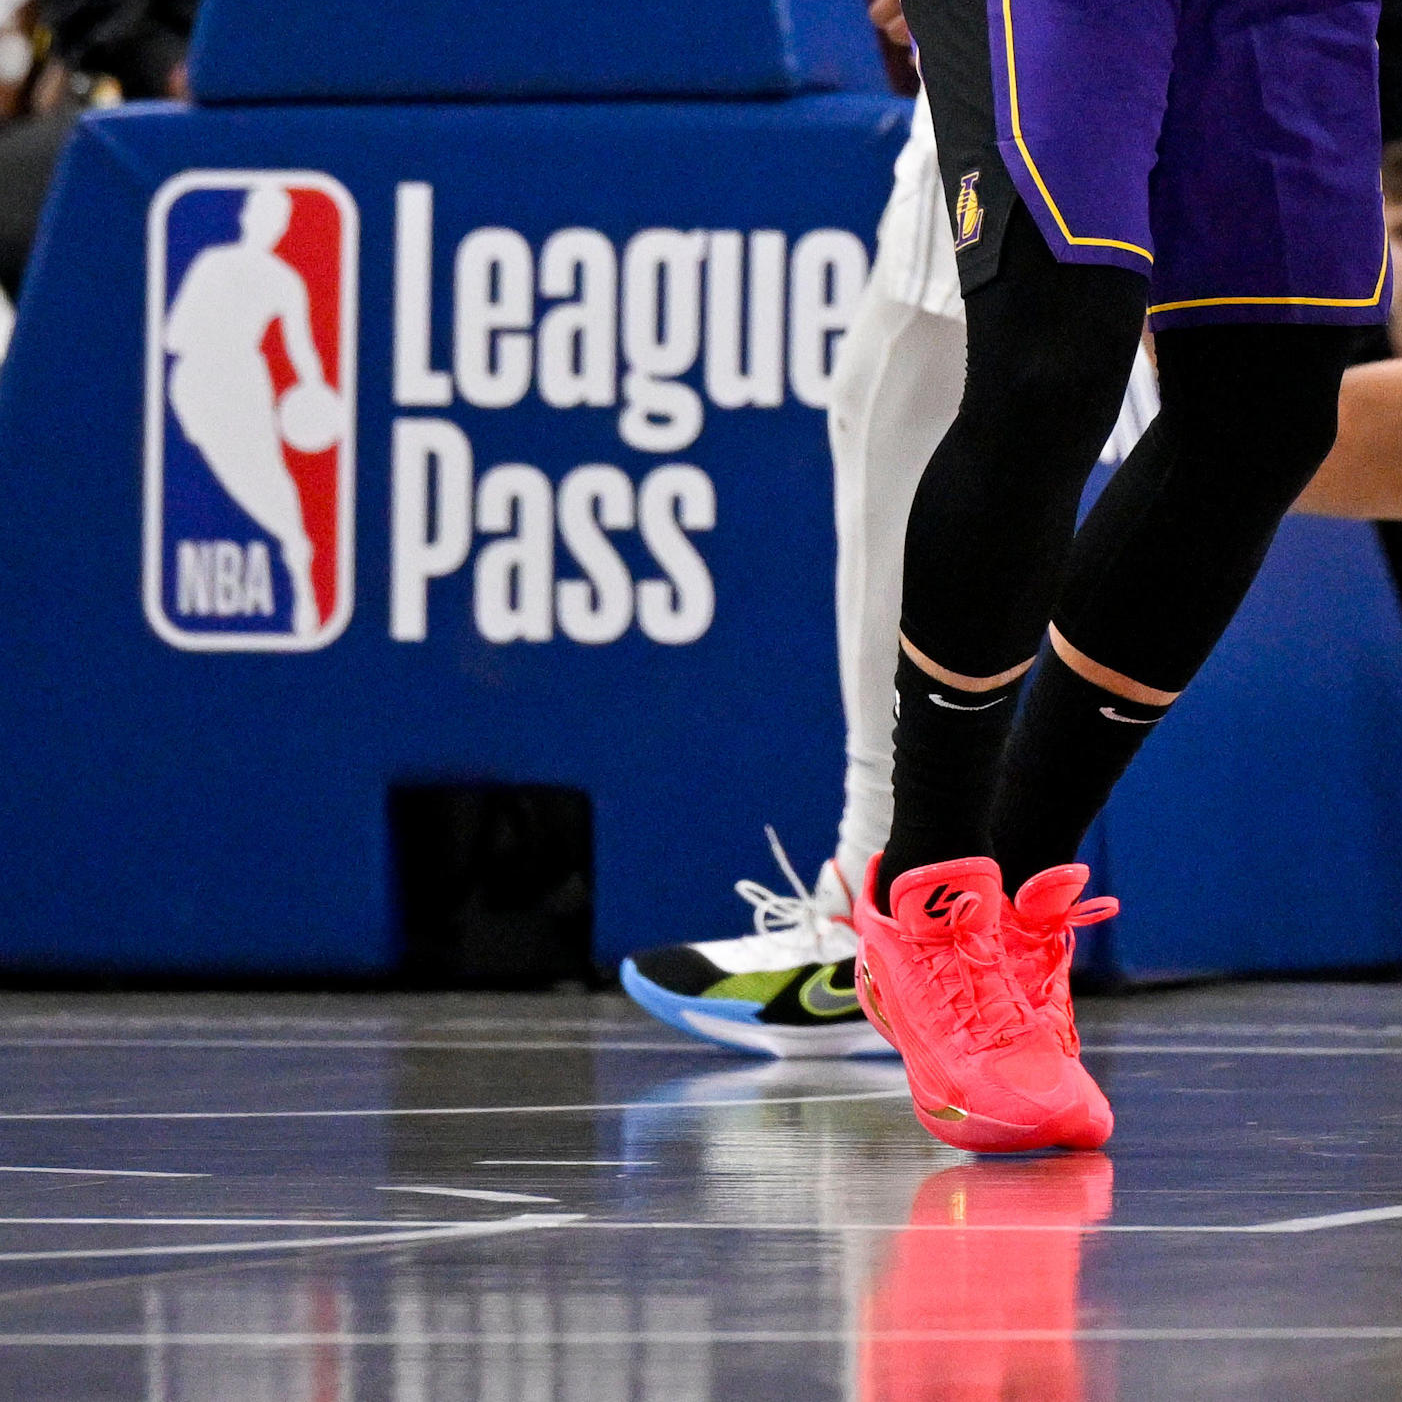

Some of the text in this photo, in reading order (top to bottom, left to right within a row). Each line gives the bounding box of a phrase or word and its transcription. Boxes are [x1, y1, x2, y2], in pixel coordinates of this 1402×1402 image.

[390, 180, 871, 454] League
[175, 539, 276, 619] NBA
[389, 416, 717, 645] Pass
